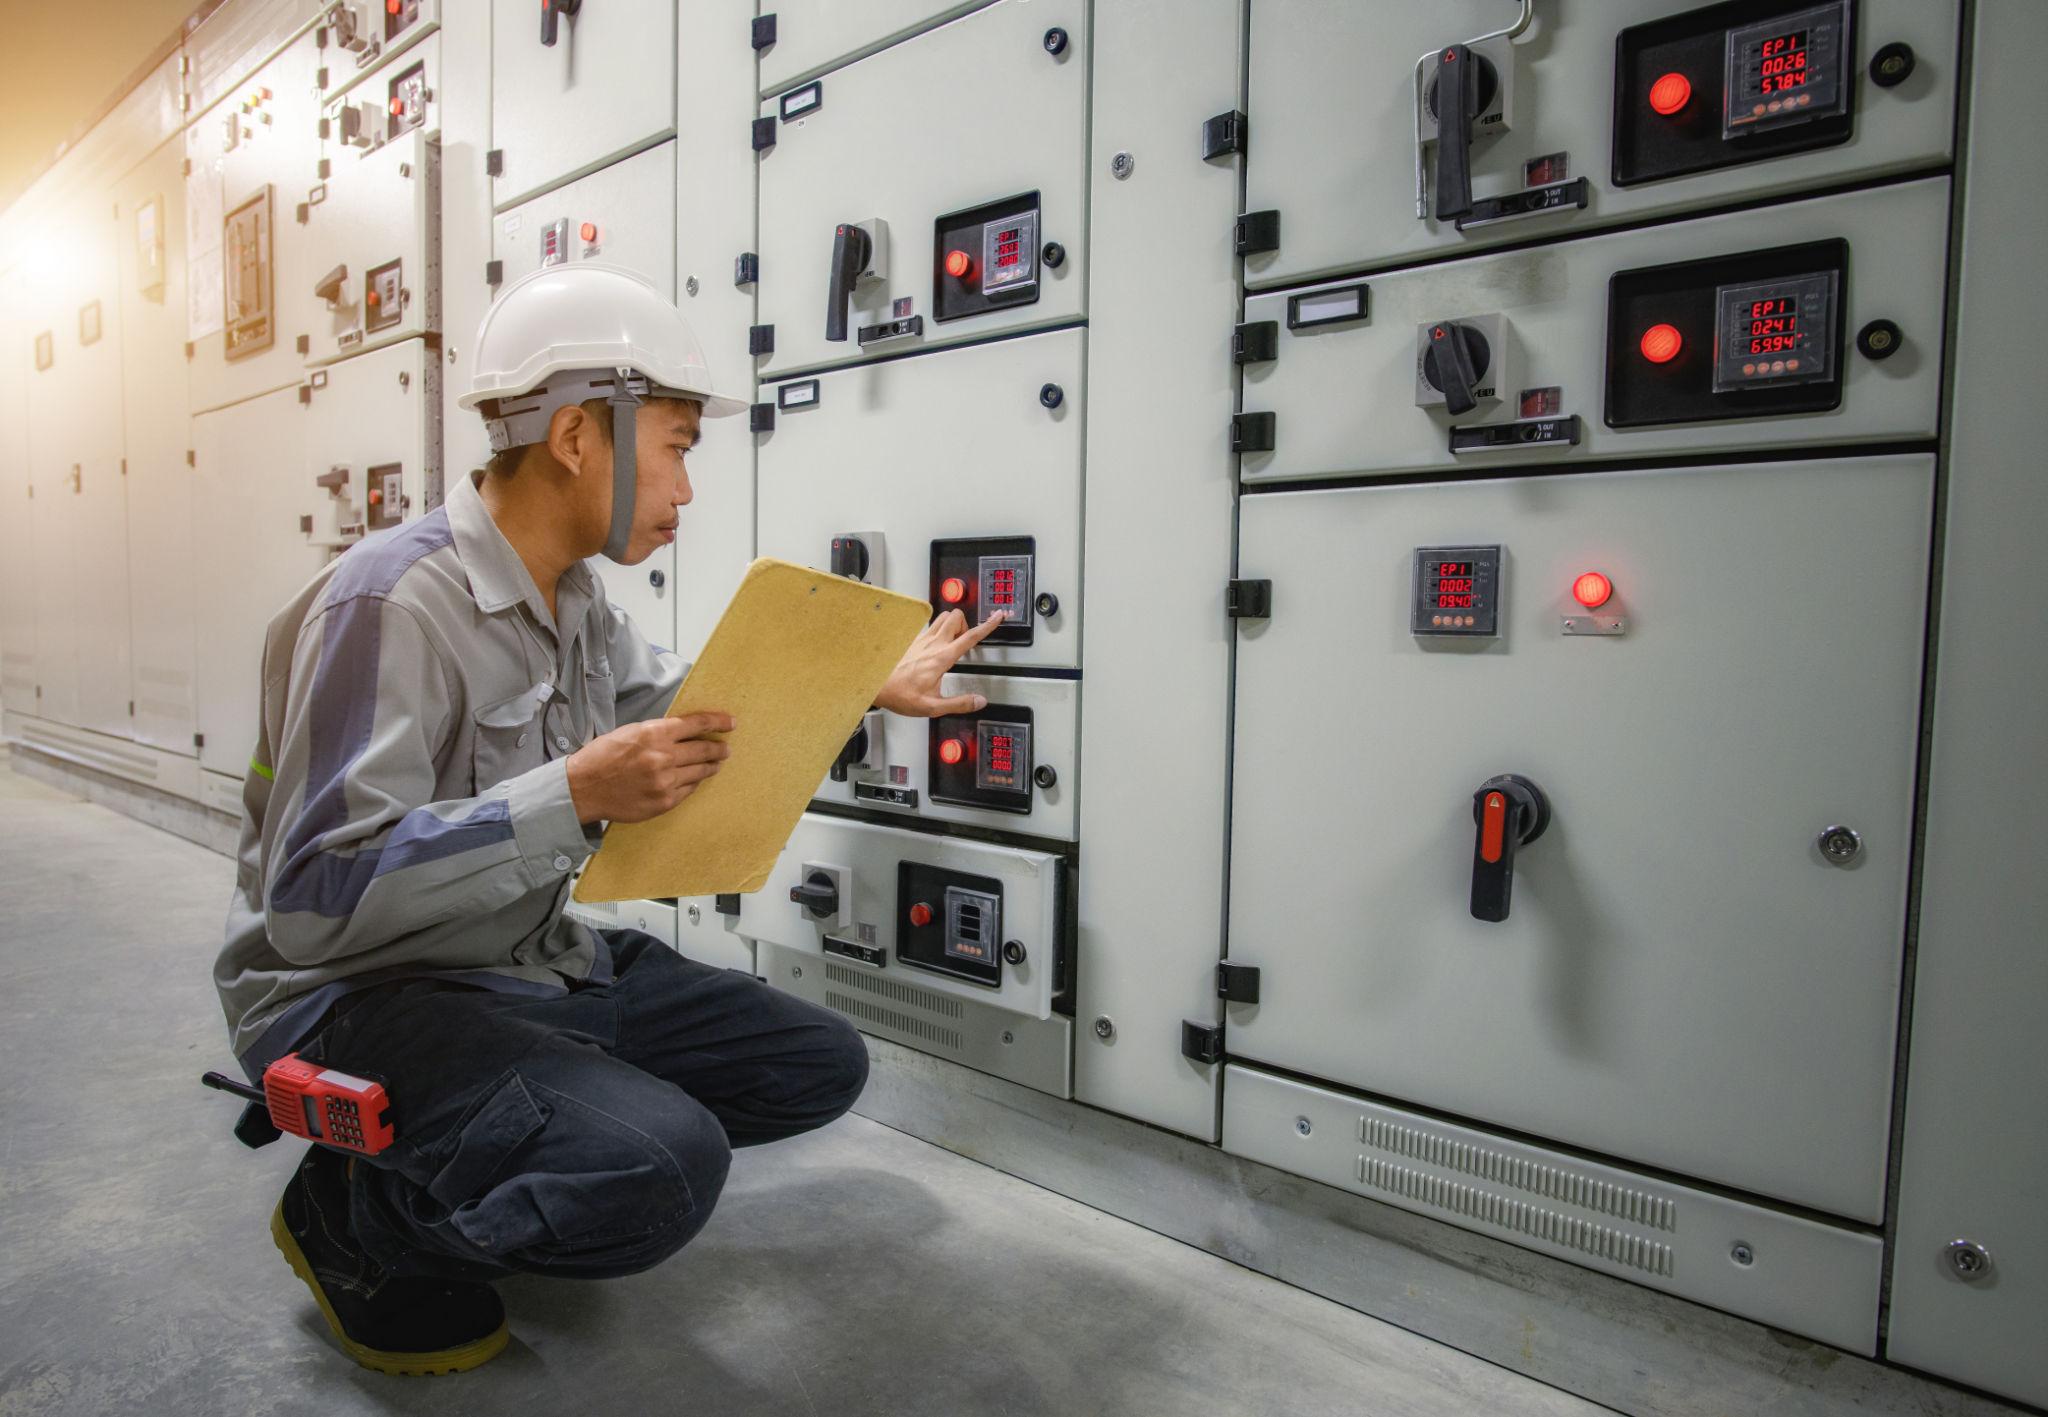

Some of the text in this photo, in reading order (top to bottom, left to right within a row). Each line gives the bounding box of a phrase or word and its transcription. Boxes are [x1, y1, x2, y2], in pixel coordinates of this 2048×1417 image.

[1762, 51, 1806, 76] 0026
[1752, 315, 1796, 336] 0241
[1440, 579, 1472, 593] 0002
